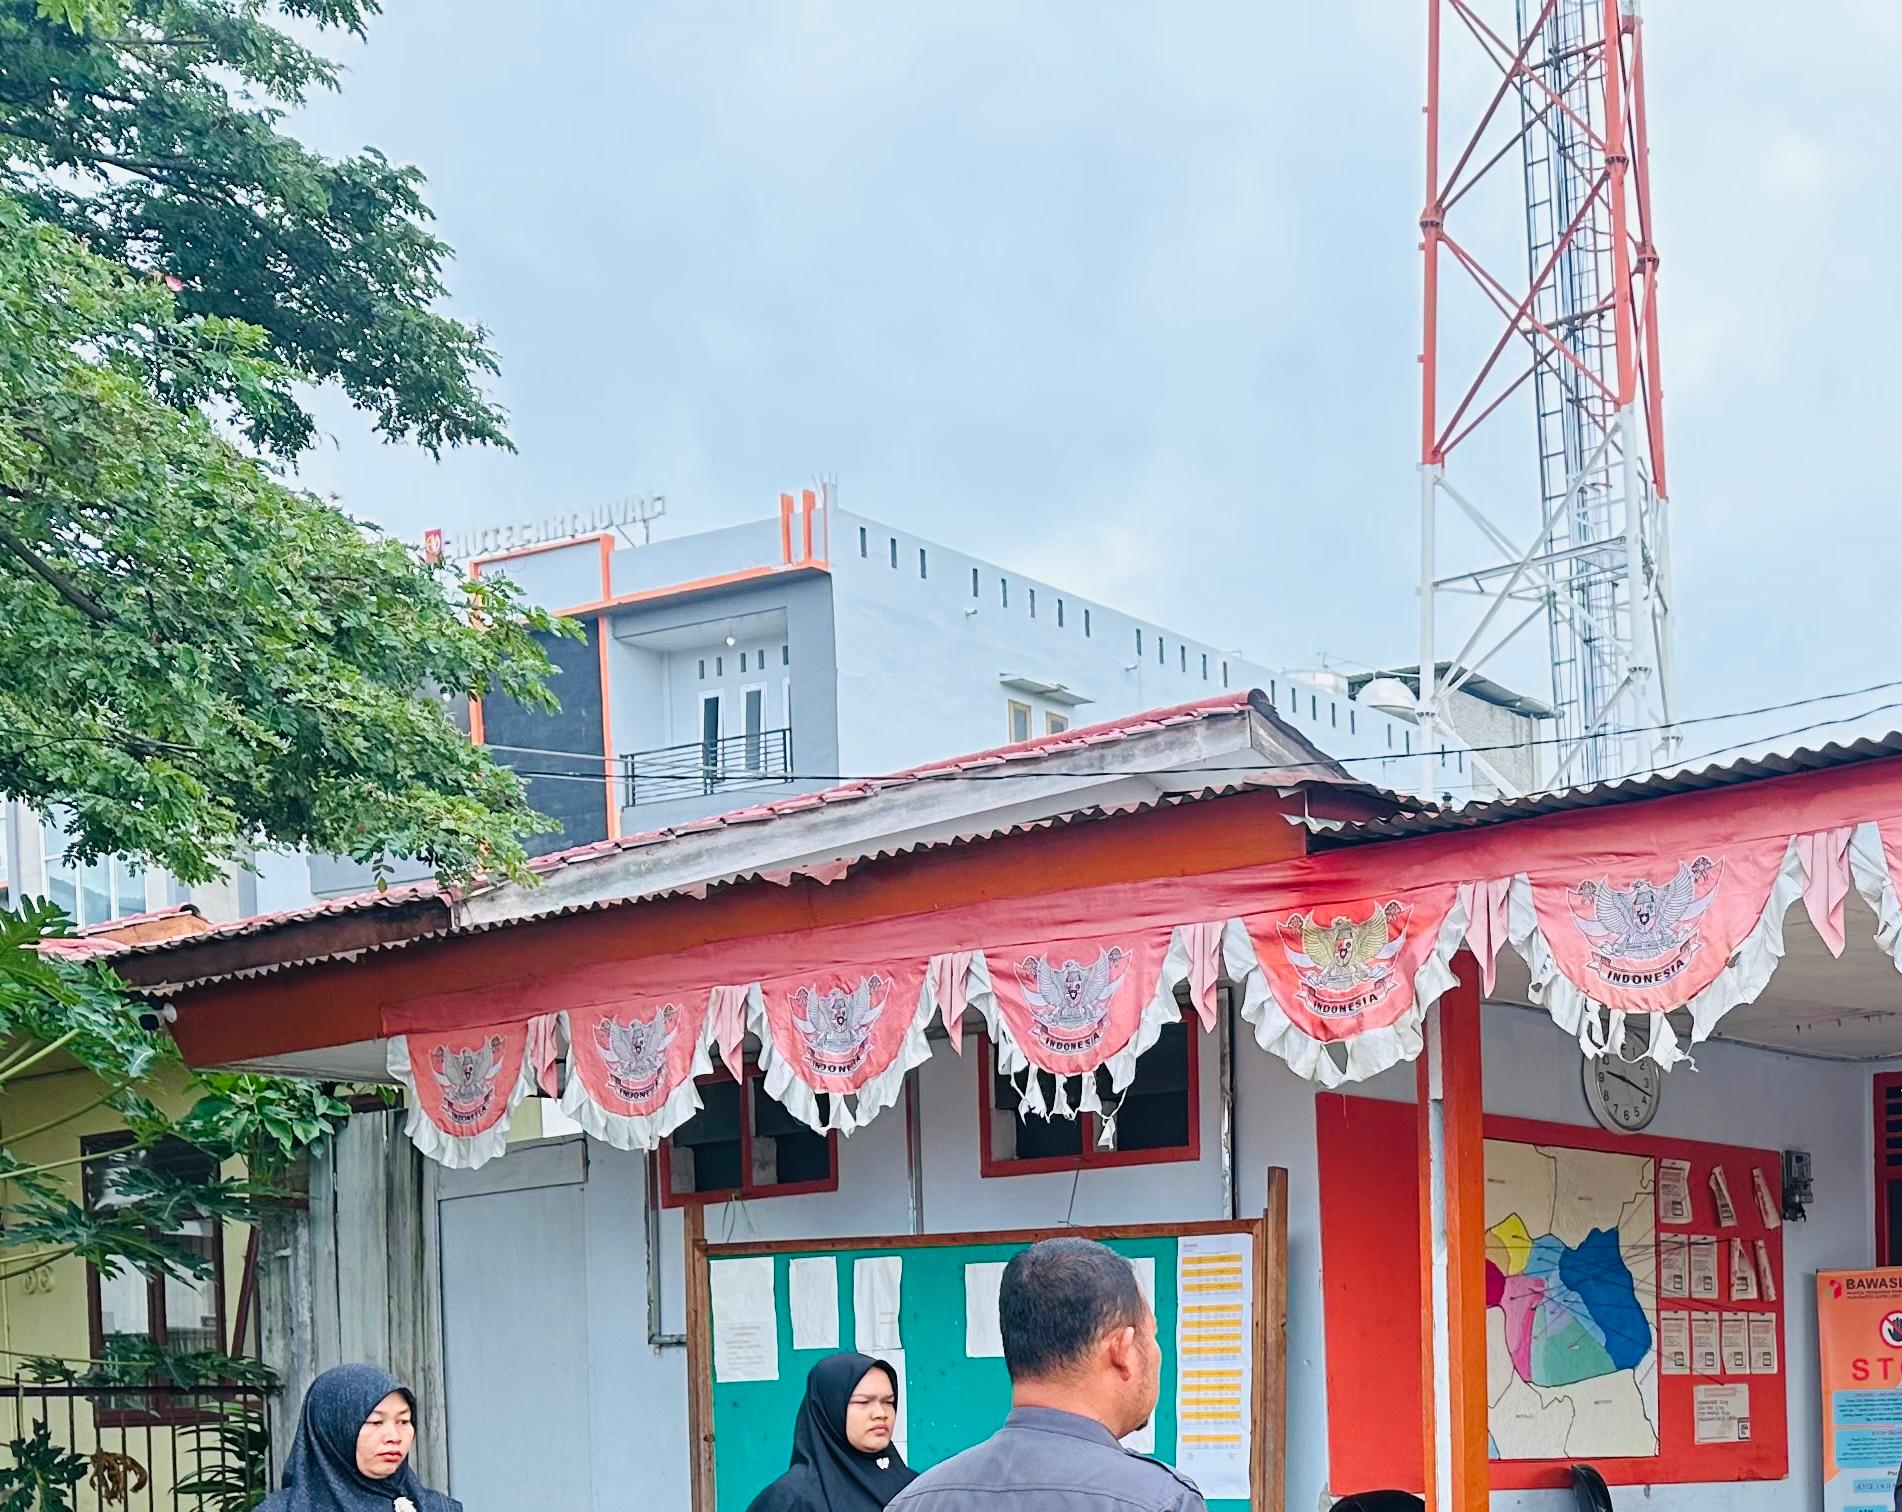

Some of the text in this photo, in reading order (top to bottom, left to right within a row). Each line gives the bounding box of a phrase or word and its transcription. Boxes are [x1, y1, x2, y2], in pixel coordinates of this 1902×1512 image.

[1607, 959, 1685, 985] INDONESIA
[1313, 993, 1379, 1013] INDONESIA
[1045, 1031, 1100, 1051] INDONESIA
[812, 1054, 861, 1073] INDONEIA
[1643, 1078, 1649, 1088] 3
[1603, 1091, 1609, 1102] 8
[1641, 1096, 1647, 1104] 4
[1613, 1104, 1618, 1114] 7
[1634, 1107, 1640, 1117] 5
[1623, 1110, 1630, 1121] 6
